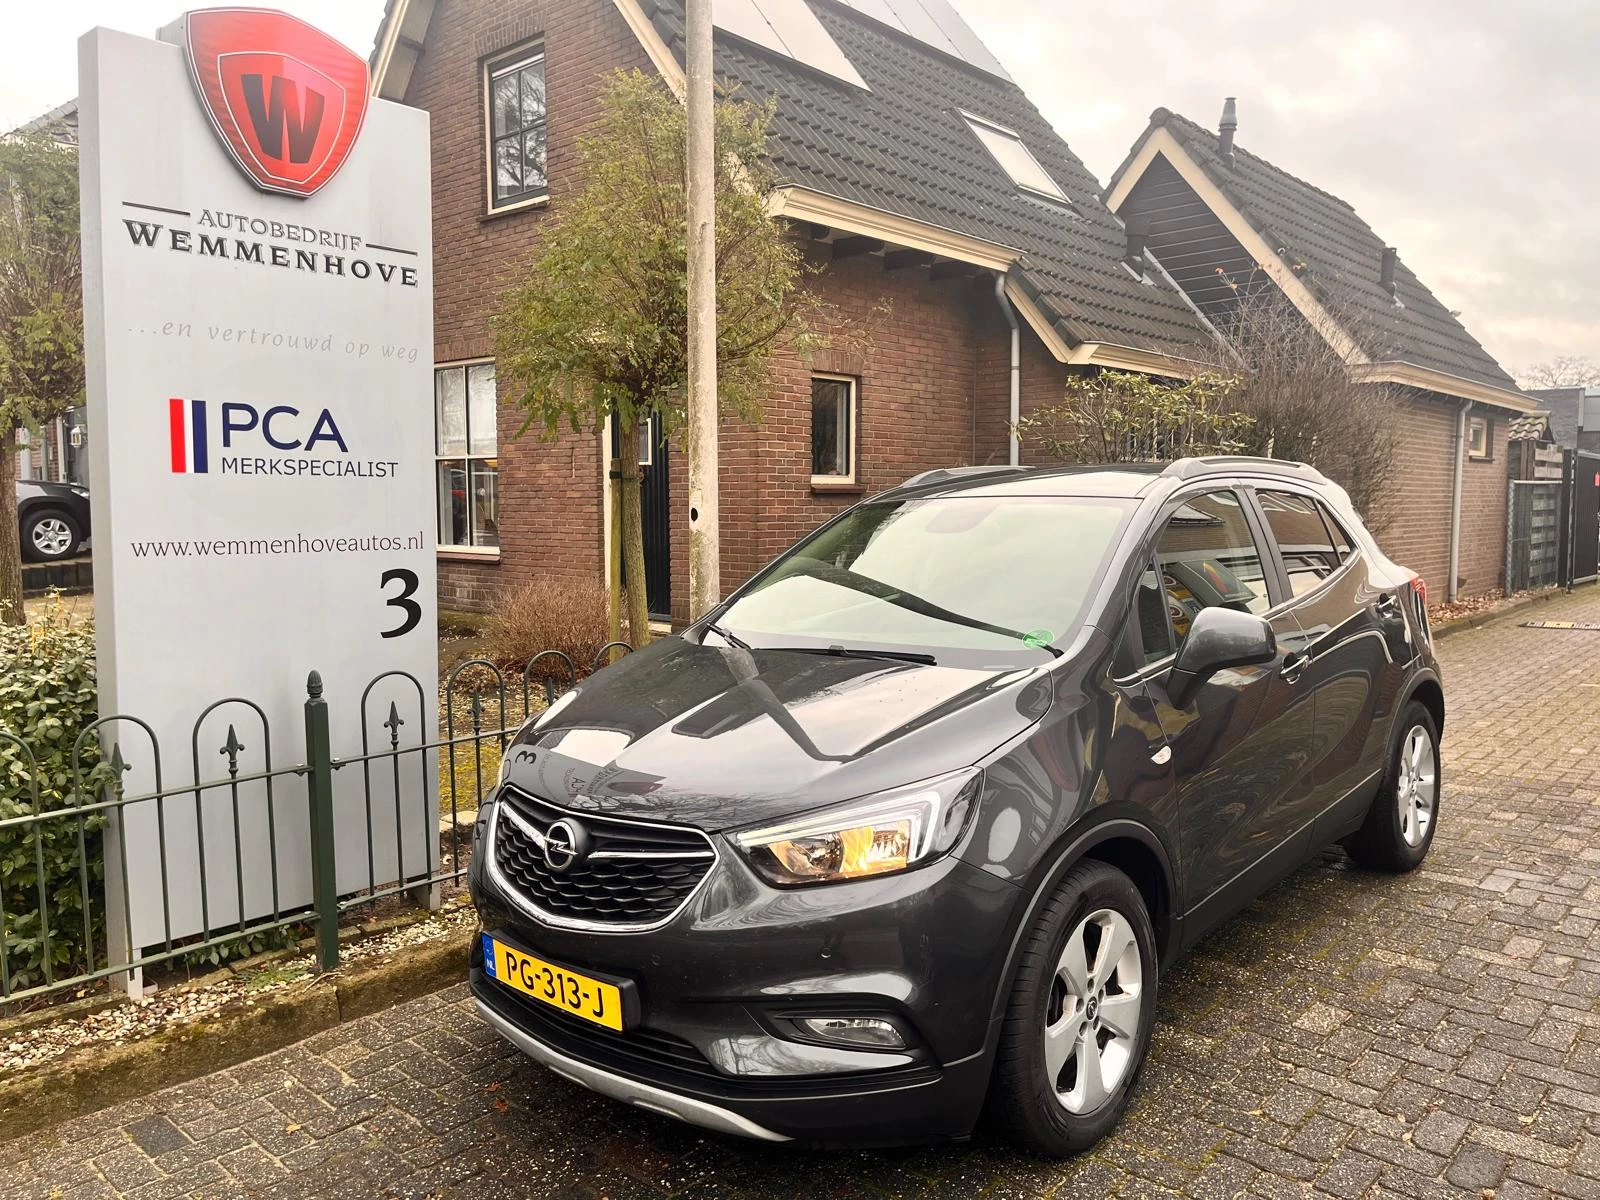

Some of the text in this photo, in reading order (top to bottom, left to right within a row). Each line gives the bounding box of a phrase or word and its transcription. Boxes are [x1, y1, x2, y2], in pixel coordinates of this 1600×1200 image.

[241, 73, 325, 164] W
[122, 218, 419, 288] WEMMENHOVE
[198, 208, 362, 251] AUTOBEDRIJF
[208, 325, 333, 353] vertrouwd
[344, 341, 371, 360] op
[381, 344, 419, 364] weg
[221, 402, 349, 453] PCA
[221, 456, 399, 478] MERKSPECIALIST
[130, 531, 425, 558] www.wemmenhoveautos.nl
[380, 568, 422, 639] 3
[505, 951, 605, 1018] PG-313-J
